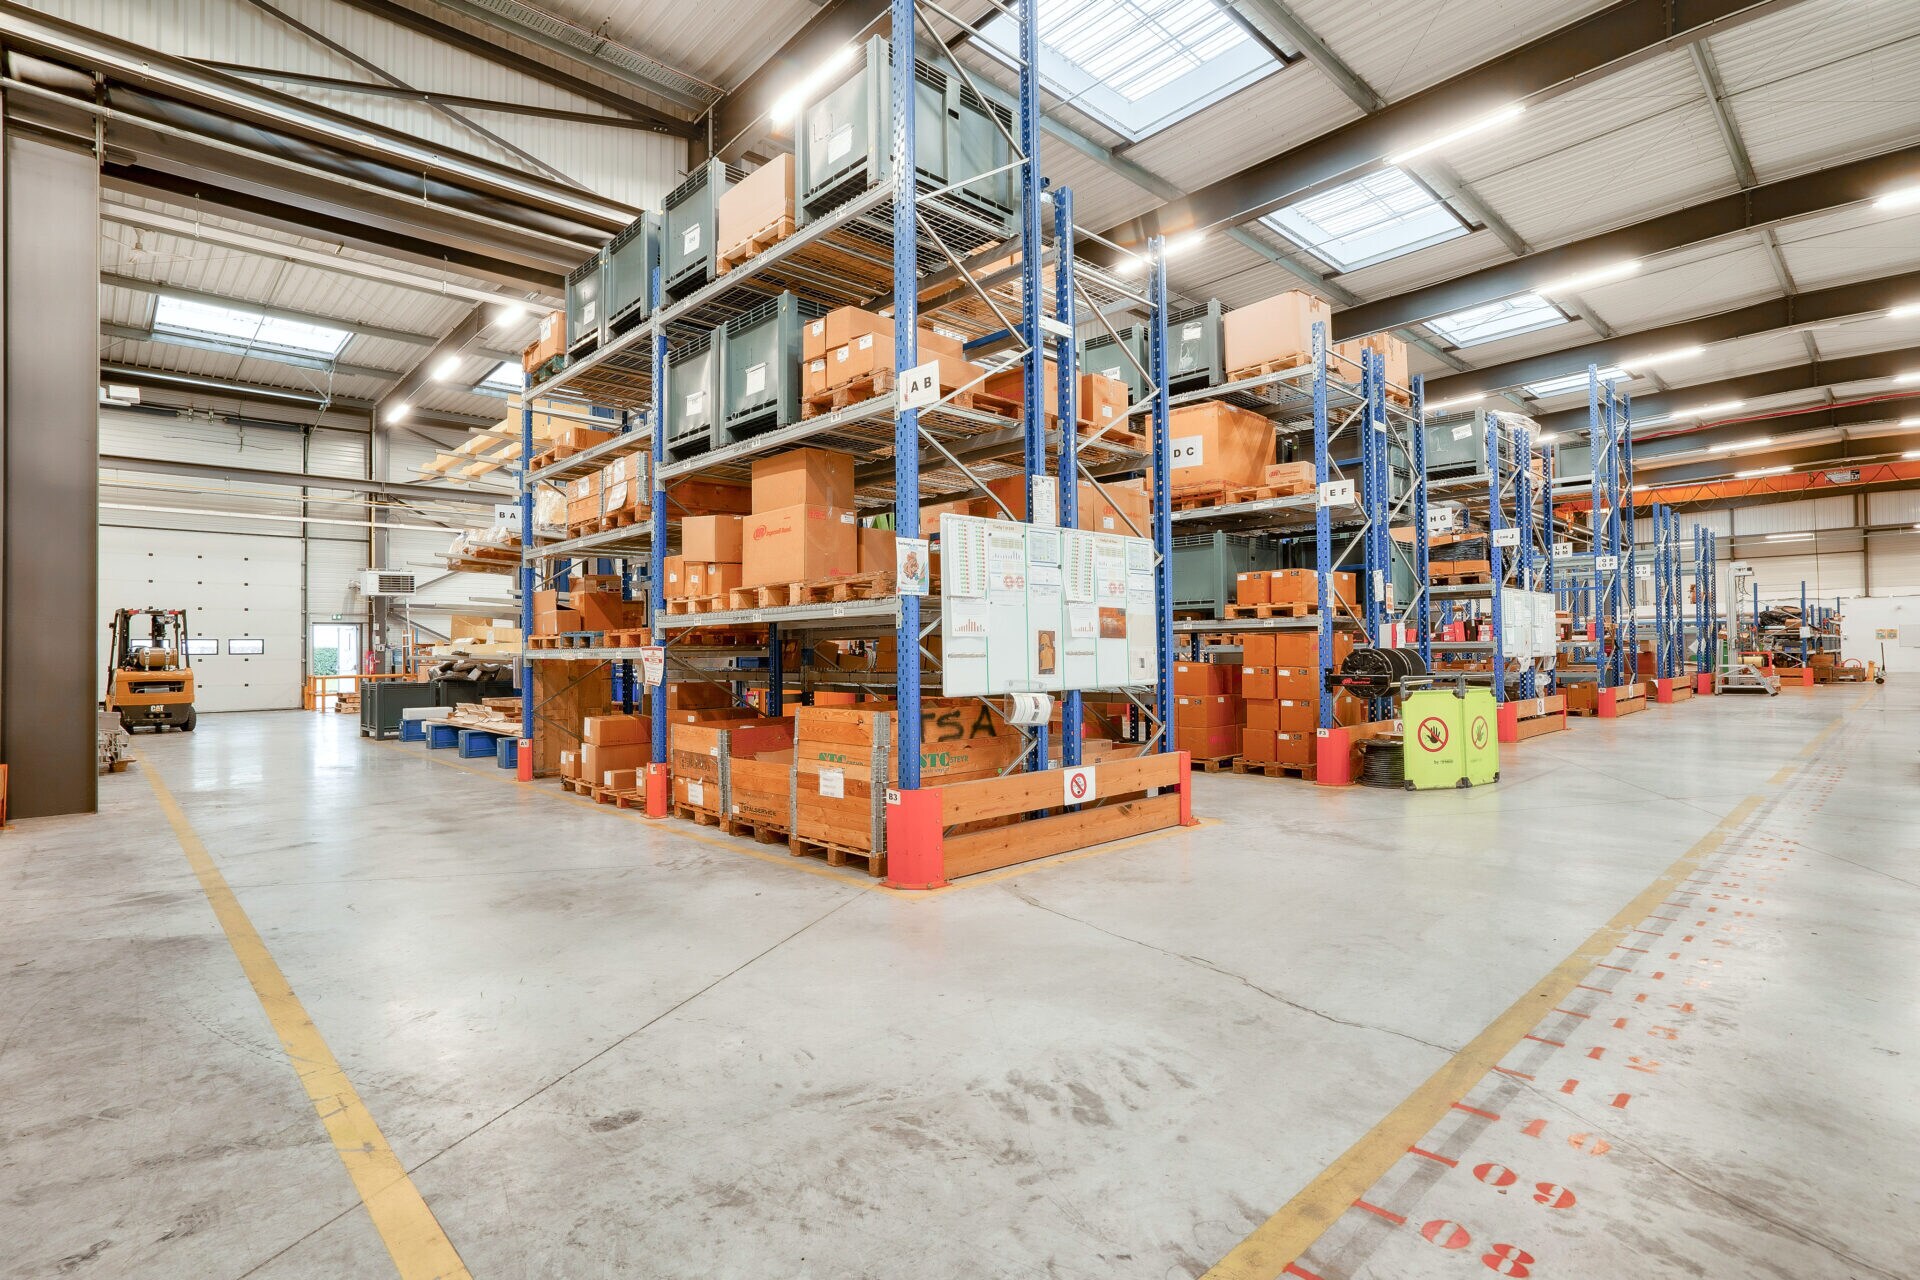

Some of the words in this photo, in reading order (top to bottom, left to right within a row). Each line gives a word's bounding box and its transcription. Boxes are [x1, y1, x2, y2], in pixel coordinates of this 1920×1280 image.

[911, 380, 919, 393] A
[924, 376, 932, 389] B
[1173, 449, 1181, 458] D
[1186, 446, 1194, 456] C
[1329, 489, 1336, 497] E
[1341, 487, 1347, 495] F
[150, 705, 165, 713] CAT
[819, 752, 847, 763] STC
[888, 792, 898, 801] B3
[1558, 1078, 1632, 1110] 11
[1519, 1118, 1612, 1157] 10
[1473, 1162, 1577, 1209] 09
[1420, 1218, 1536, 1279] 08
